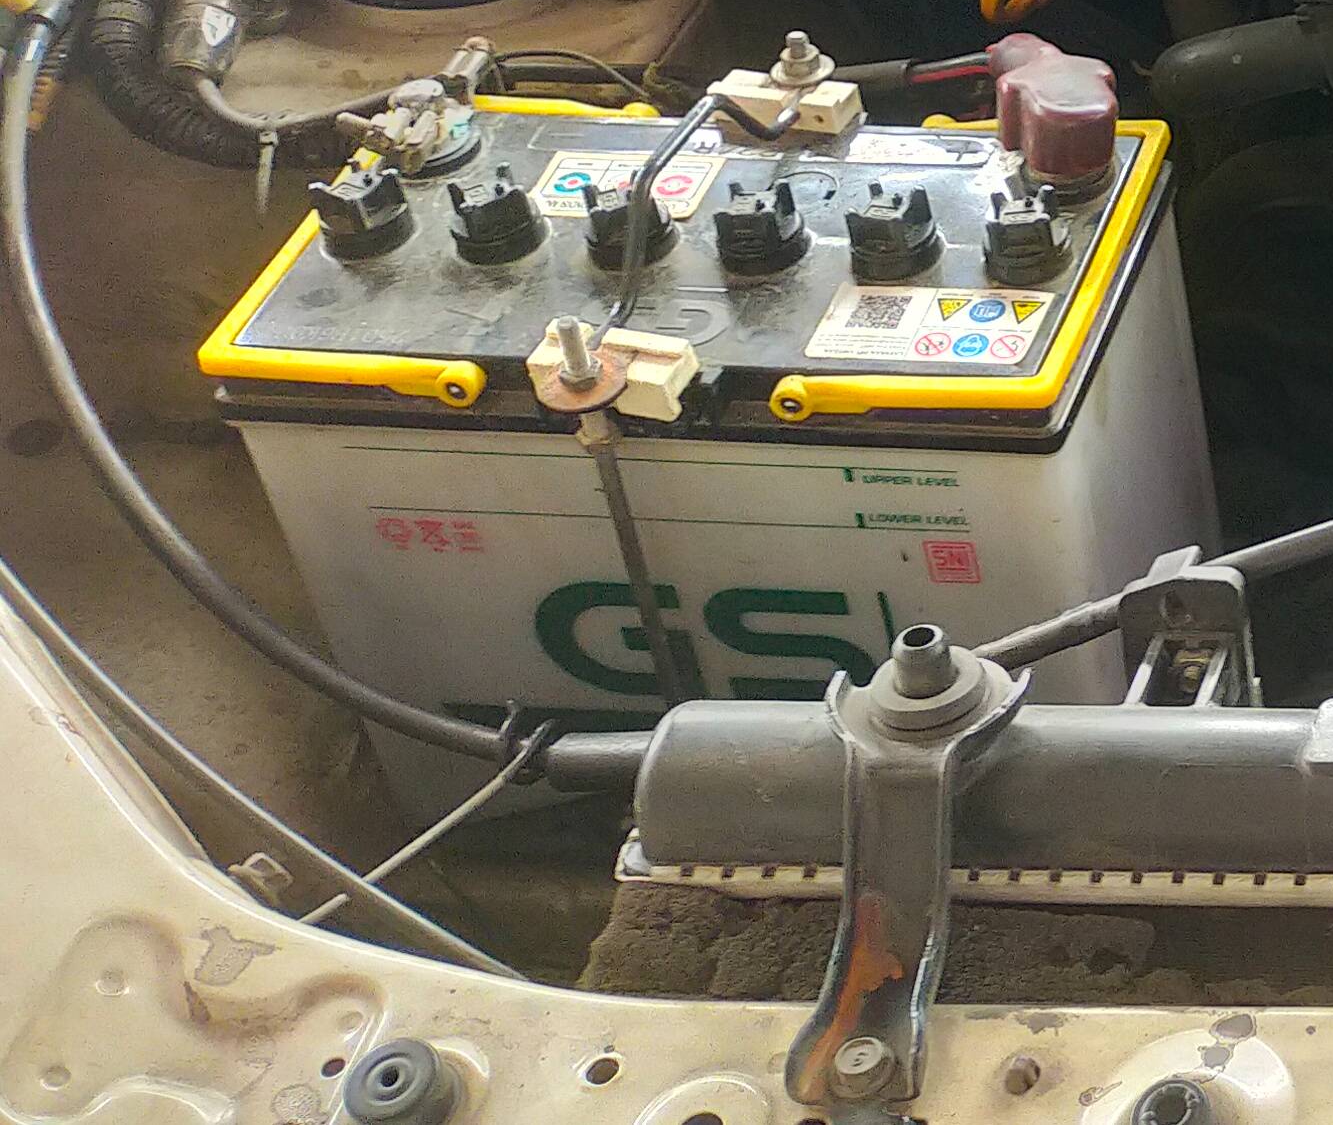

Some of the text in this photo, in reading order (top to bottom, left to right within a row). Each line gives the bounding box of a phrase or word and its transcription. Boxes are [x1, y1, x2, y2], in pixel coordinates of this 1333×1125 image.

[863, 475, 960, 487] UPPER LEVEL
[868, 513, 970, 526] LOWER LEVEL
[535, 580, 877, 701] GS
